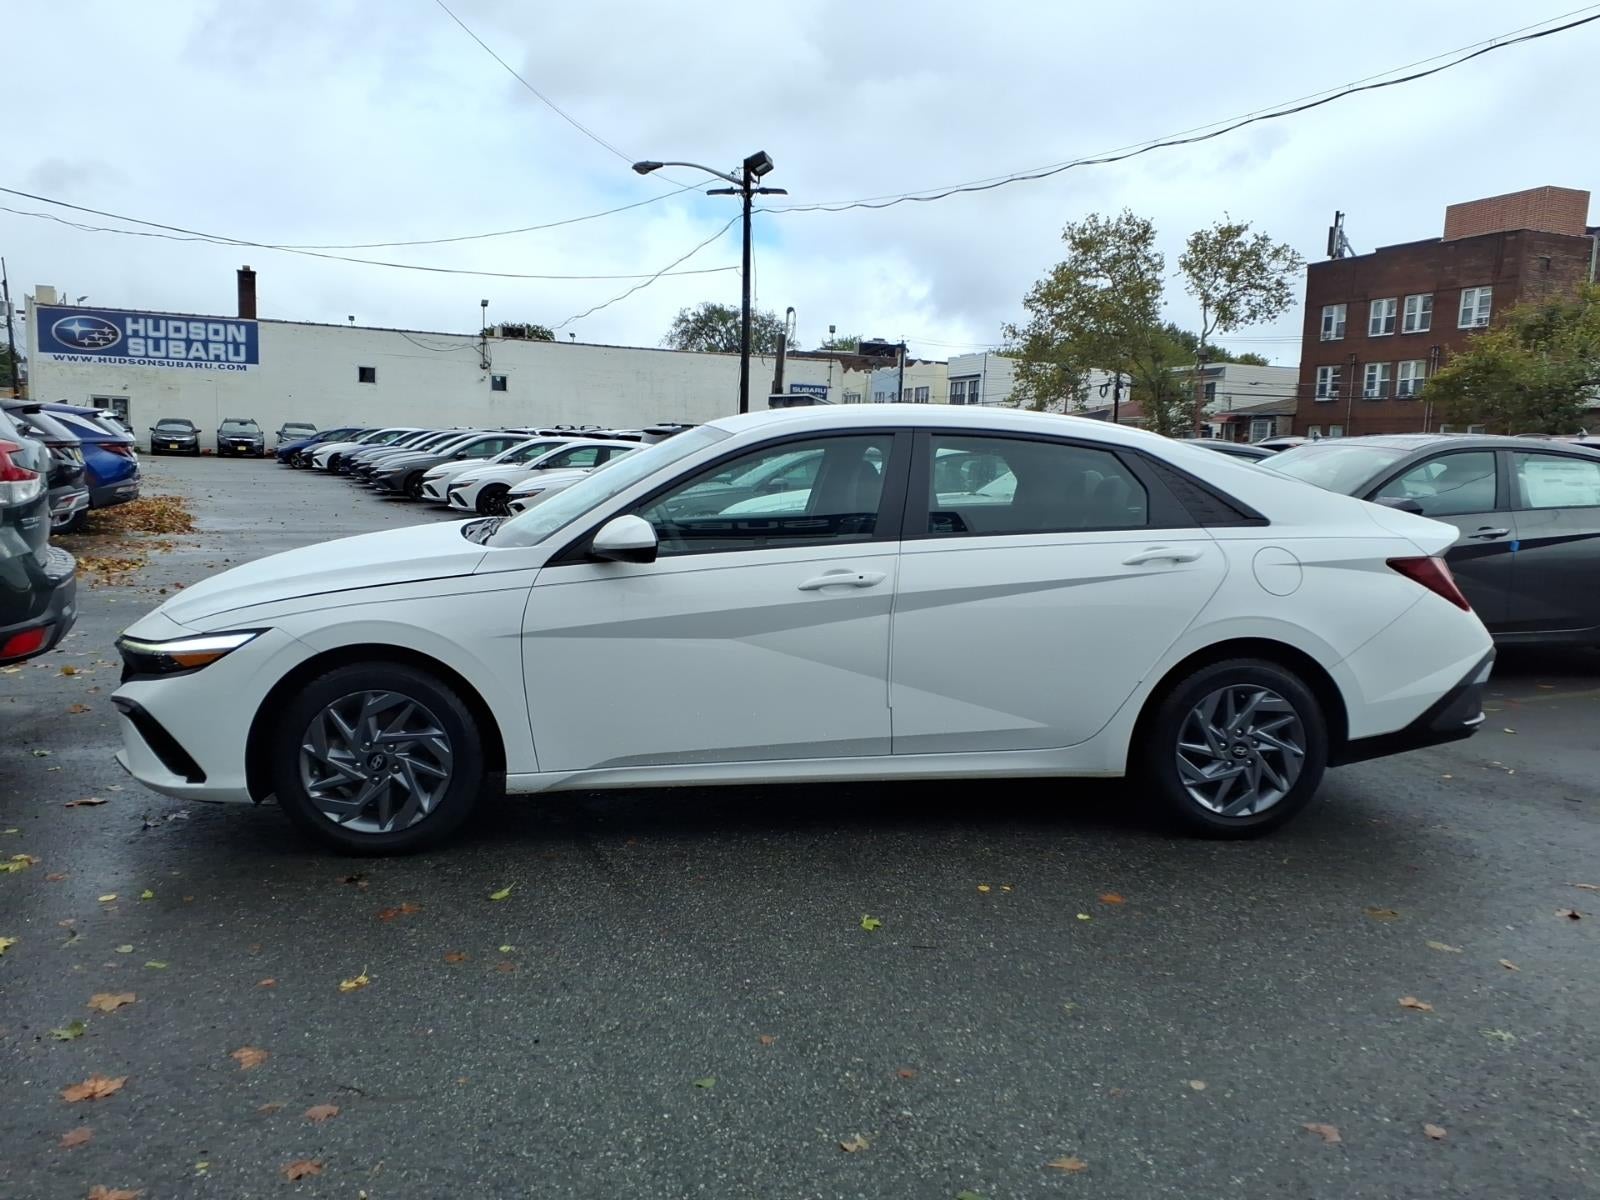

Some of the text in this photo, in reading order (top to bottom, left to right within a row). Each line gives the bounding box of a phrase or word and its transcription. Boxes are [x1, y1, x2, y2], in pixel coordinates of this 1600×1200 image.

[125, 317, 246, 343] HUDSON
[127, 337, 246, 363] SUBARU
[52, 353, 248, 372] WWW.HUDSONSUBARU.COM
[792, 386, 827, 394] SUBARU
